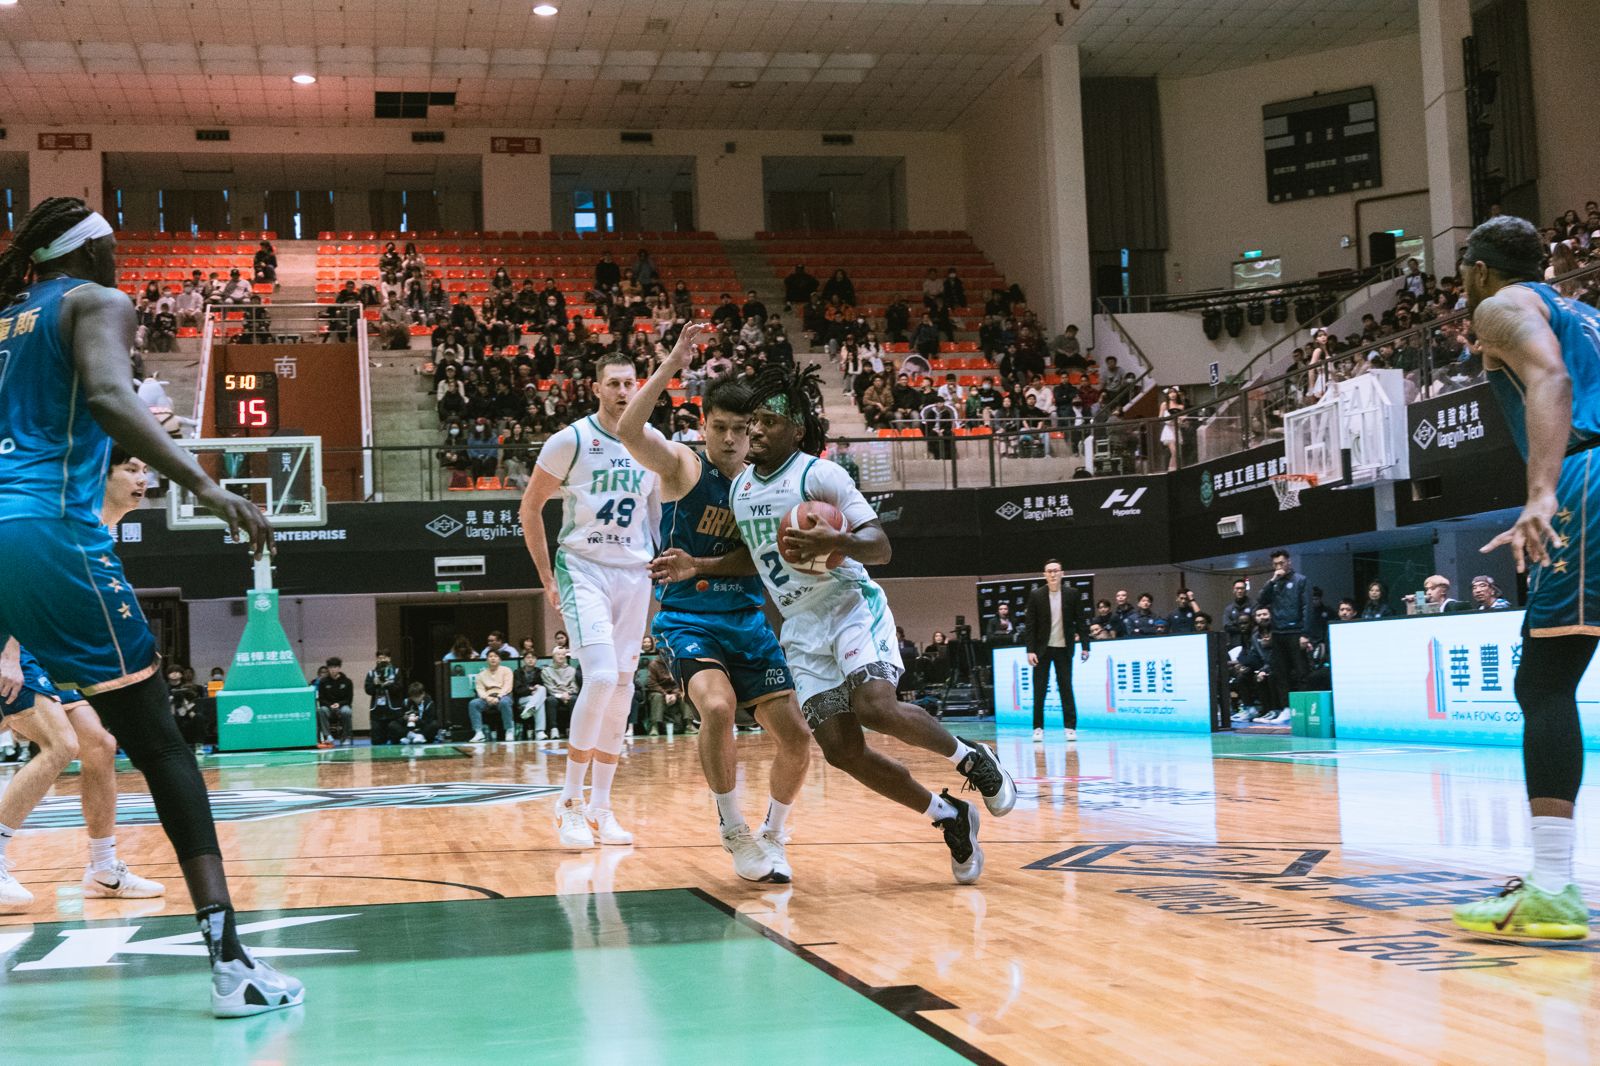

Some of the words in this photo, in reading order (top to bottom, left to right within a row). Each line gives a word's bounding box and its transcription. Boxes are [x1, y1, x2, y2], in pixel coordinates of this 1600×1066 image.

[273, 355, 297, 379] 南
[239, 399, 268, 426] 15
[610, 458, 631, 467] YKE
[590, 469, 646, 496] ARK
[466, 510, 522, 524] 晃誼科
[596, 498, 636, 528] 49
[750, 504, 772, 516] YKE
[273, 529, 346, 541] ENTERPRISE
[465, 525, 524, 540] Uangyih-Te
[1474, 711, 1501, 721] FONG
